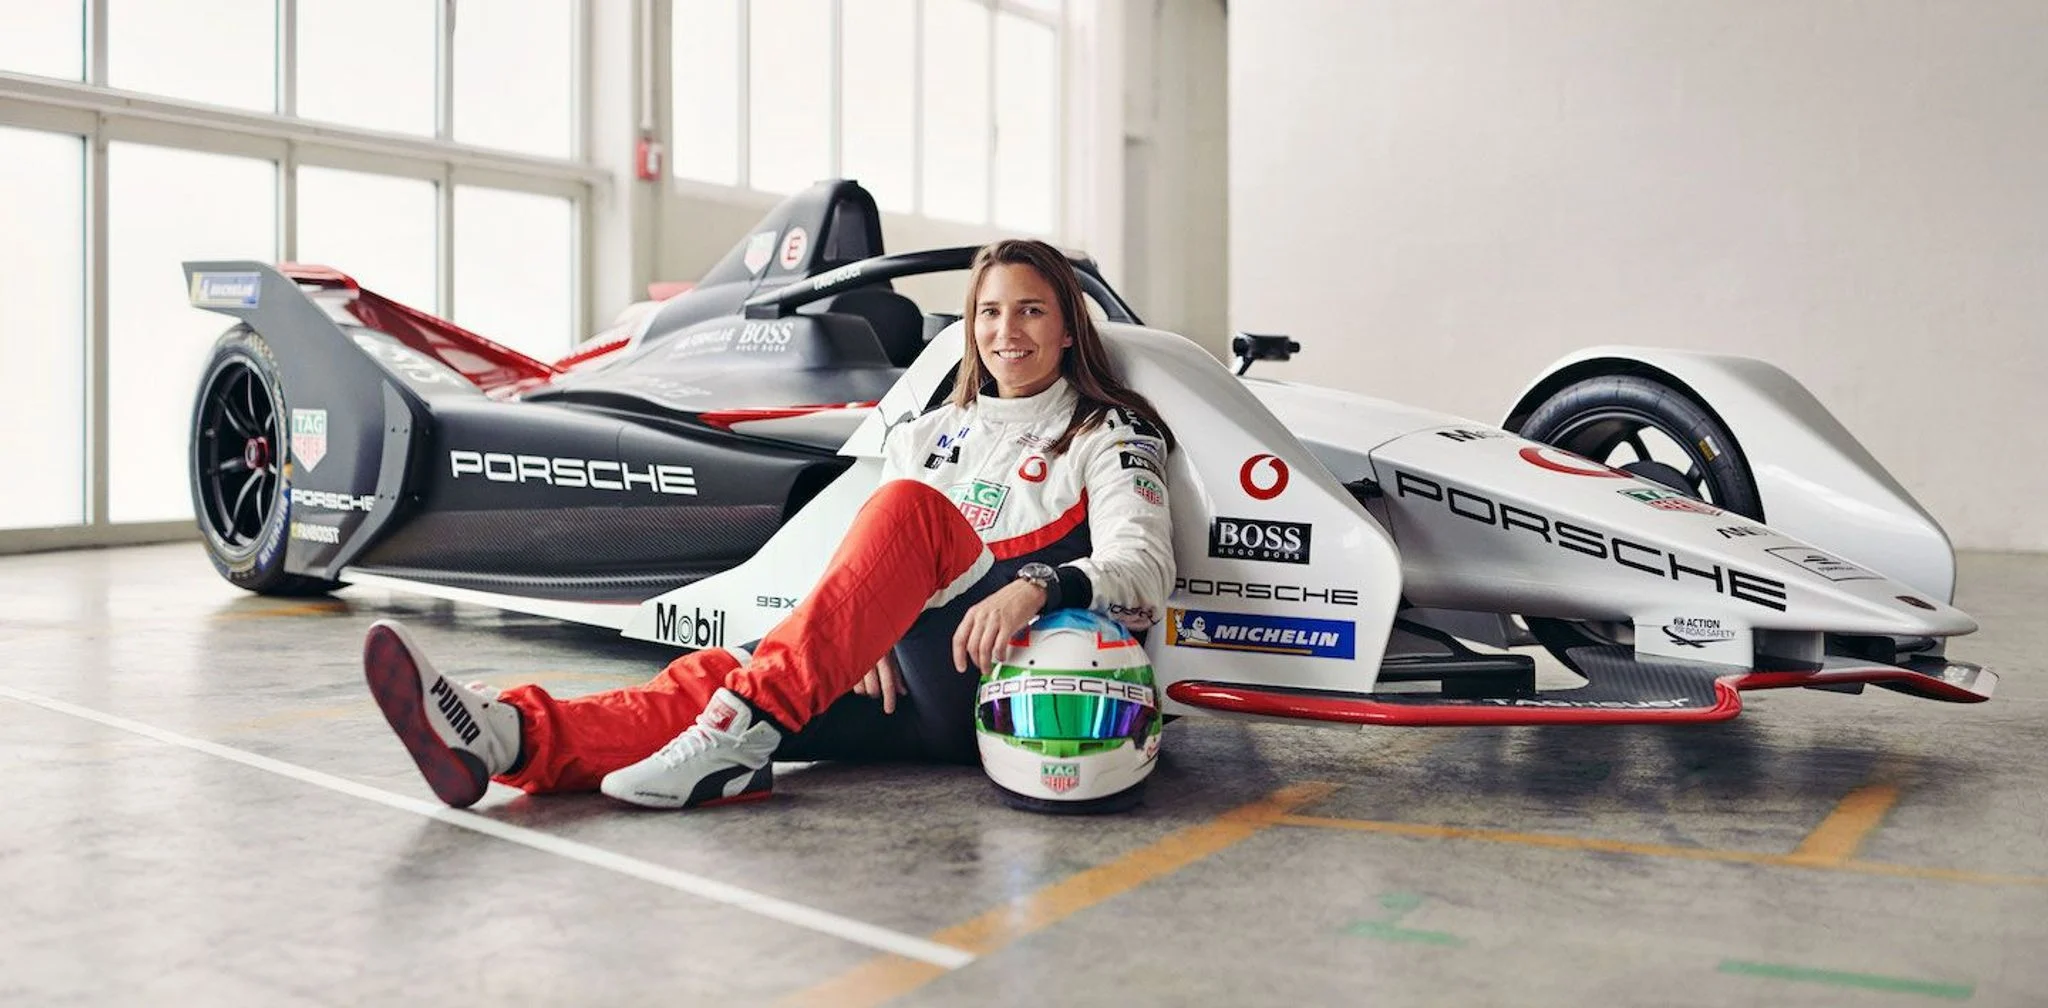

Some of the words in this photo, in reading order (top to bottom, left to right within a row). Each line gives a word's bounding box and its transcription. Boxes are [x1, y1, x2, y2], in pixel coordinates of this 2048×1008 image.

[738, 322, 794, 344] BOSS
[294, 415, 323, 433] TAG
[449, 450, 698, 496] PORSCHE
[290, 488, 376, 512] PORSCHE
[1218, 521, 1302, 551] BOSS
[1395, 470, 1788, 612] PORSCHE
[1217, 548, 1255, 557] HUGO
[1263, 550, 1300, 560] BOSS
[756, 595, 798, 609] 99X
[1175, 577, 1359, 606] PORSCHE
[655, 602, 726, 648] Mobil
[1687, 618, 1721, 629] ACTION
[1707, 629, 1736, 638] SAFETY
[1213, 624, 1340, 648] MICHELIN
[987, 677, 1144, 701] PORSCHE
[430, 675, 481, 746] PUMA
[1046, 764, 1076, 776] TAG
